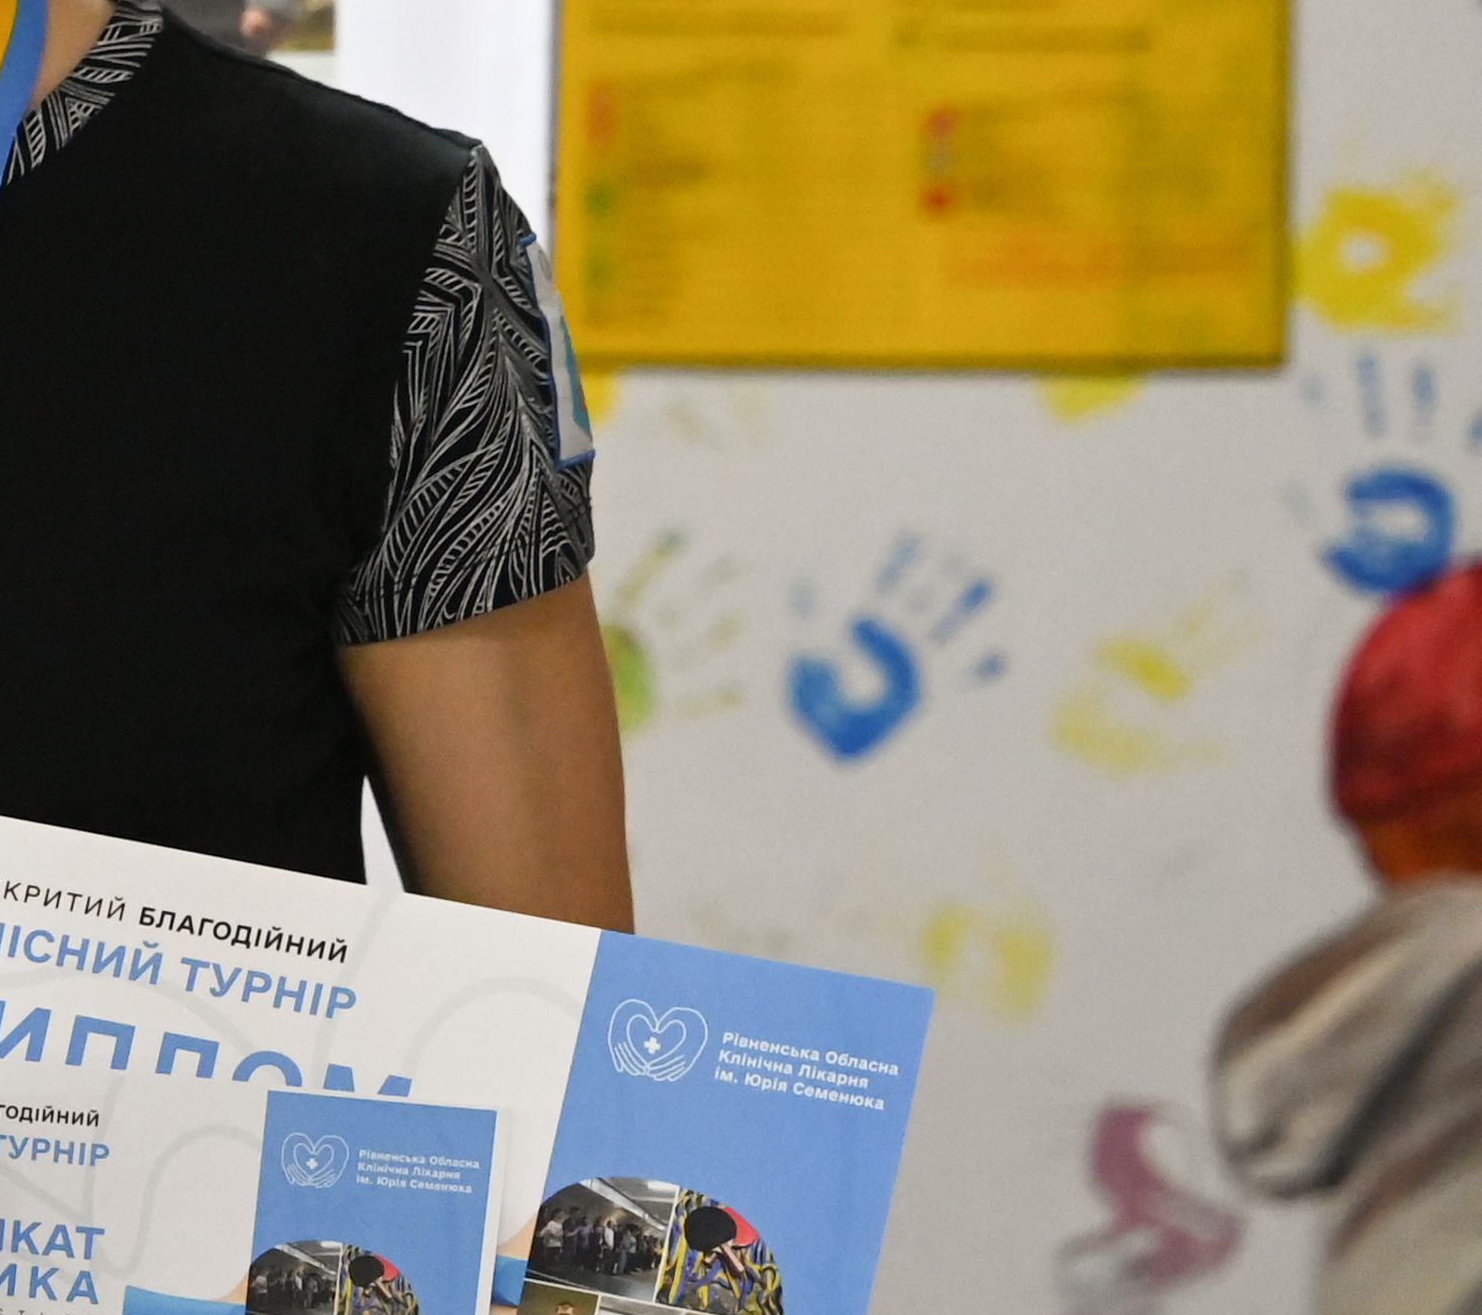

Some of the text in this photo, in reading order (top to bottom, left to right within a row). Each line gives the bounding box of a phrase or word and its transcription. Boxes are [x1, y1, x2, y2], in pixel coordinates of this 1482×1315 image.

[138, 906, 348, 964] БЛАГОДІЙНИЙ
[180, 957, 356, 1019] ТУРНІР
[718, 1049, 869, 1089] Клінічна Лікарня
[722, 1032, 899, 1076] Рівненська Обласна
[715, 1066, 885, 1111] ім. Юрія Семенюка
[358, 1162, 461, 1180] Клінічна Лікарня
[359, 1149, 480, 1168] Рівненська Обласна
[377, 1176, 406, 1188] Юрія
[410, 1179, 472, 1193] Семенюка
